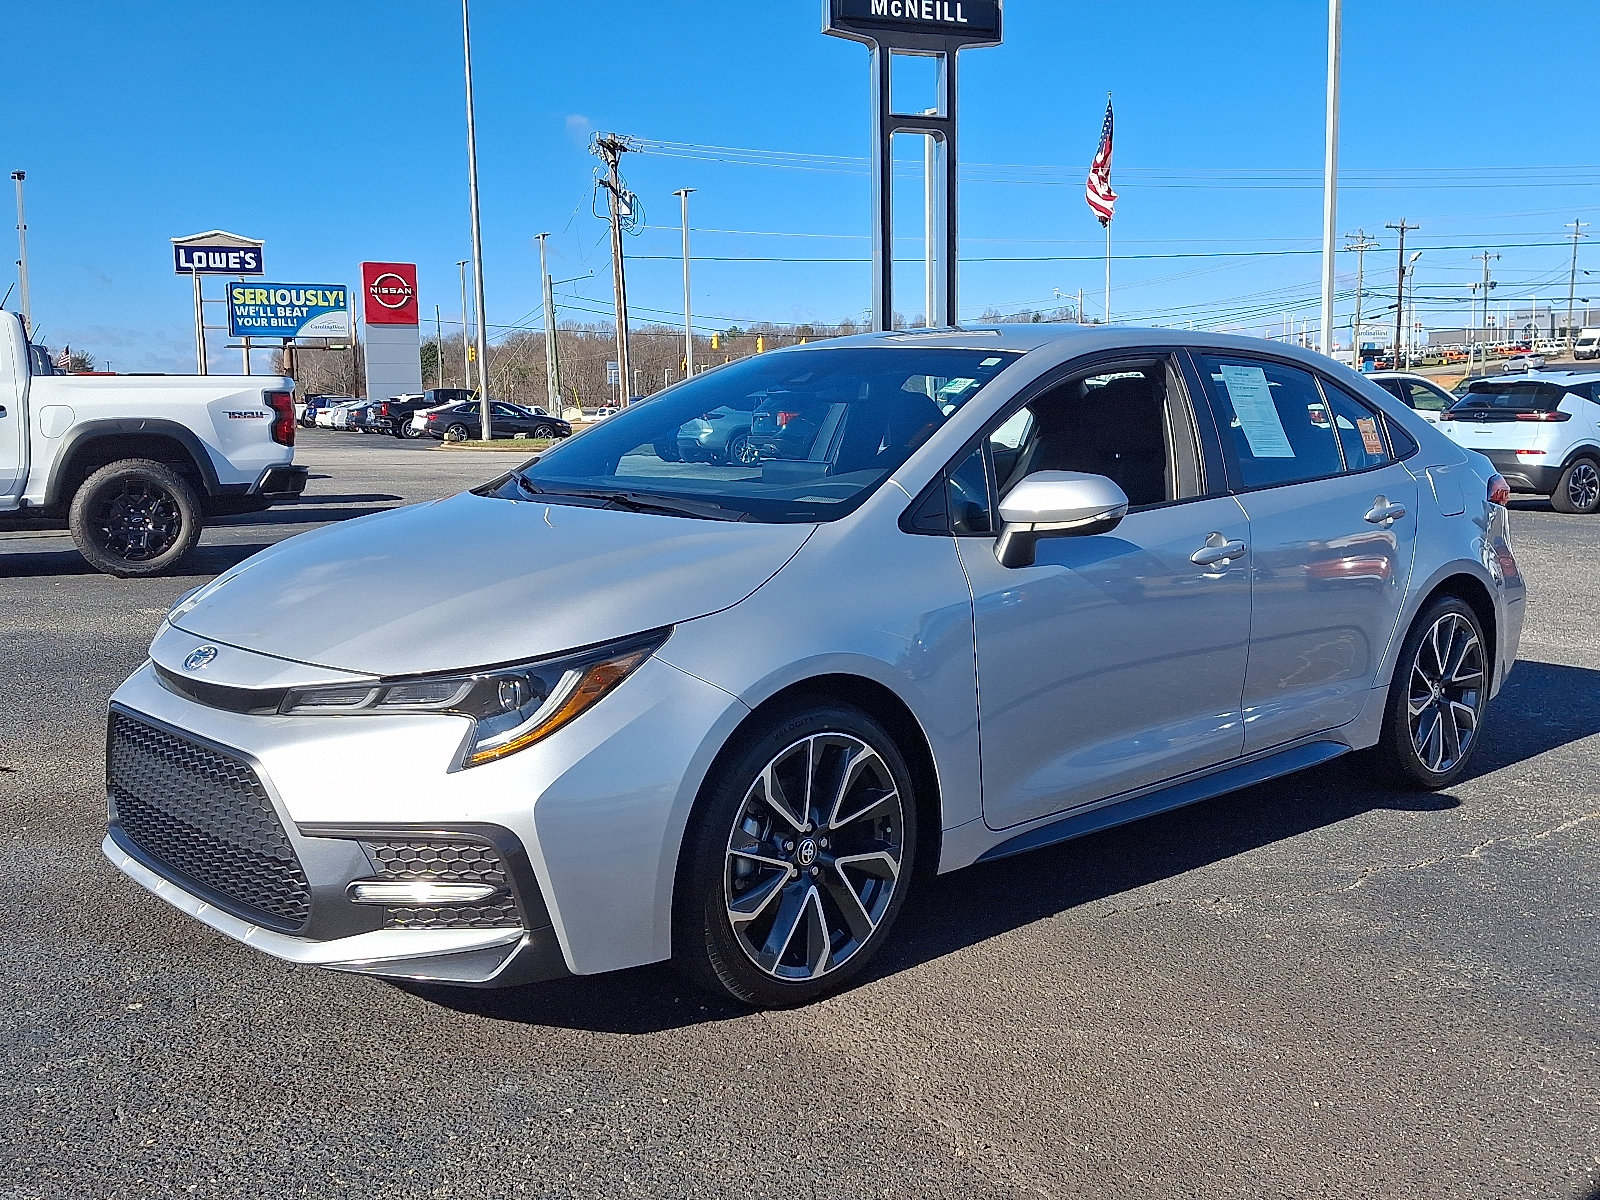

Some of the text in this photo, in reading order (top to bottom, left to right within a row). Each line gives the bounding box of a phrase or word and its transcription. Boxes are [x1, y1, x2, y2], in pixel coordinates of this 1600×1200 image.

[179, 249, 257, 269] LOWE'S
[232, 288, 345, 307] SERIOUSLY!
[235, 305, 309, 318] WE'LL BEAT
[236, 317, 298, 327] YOUR BILL!
